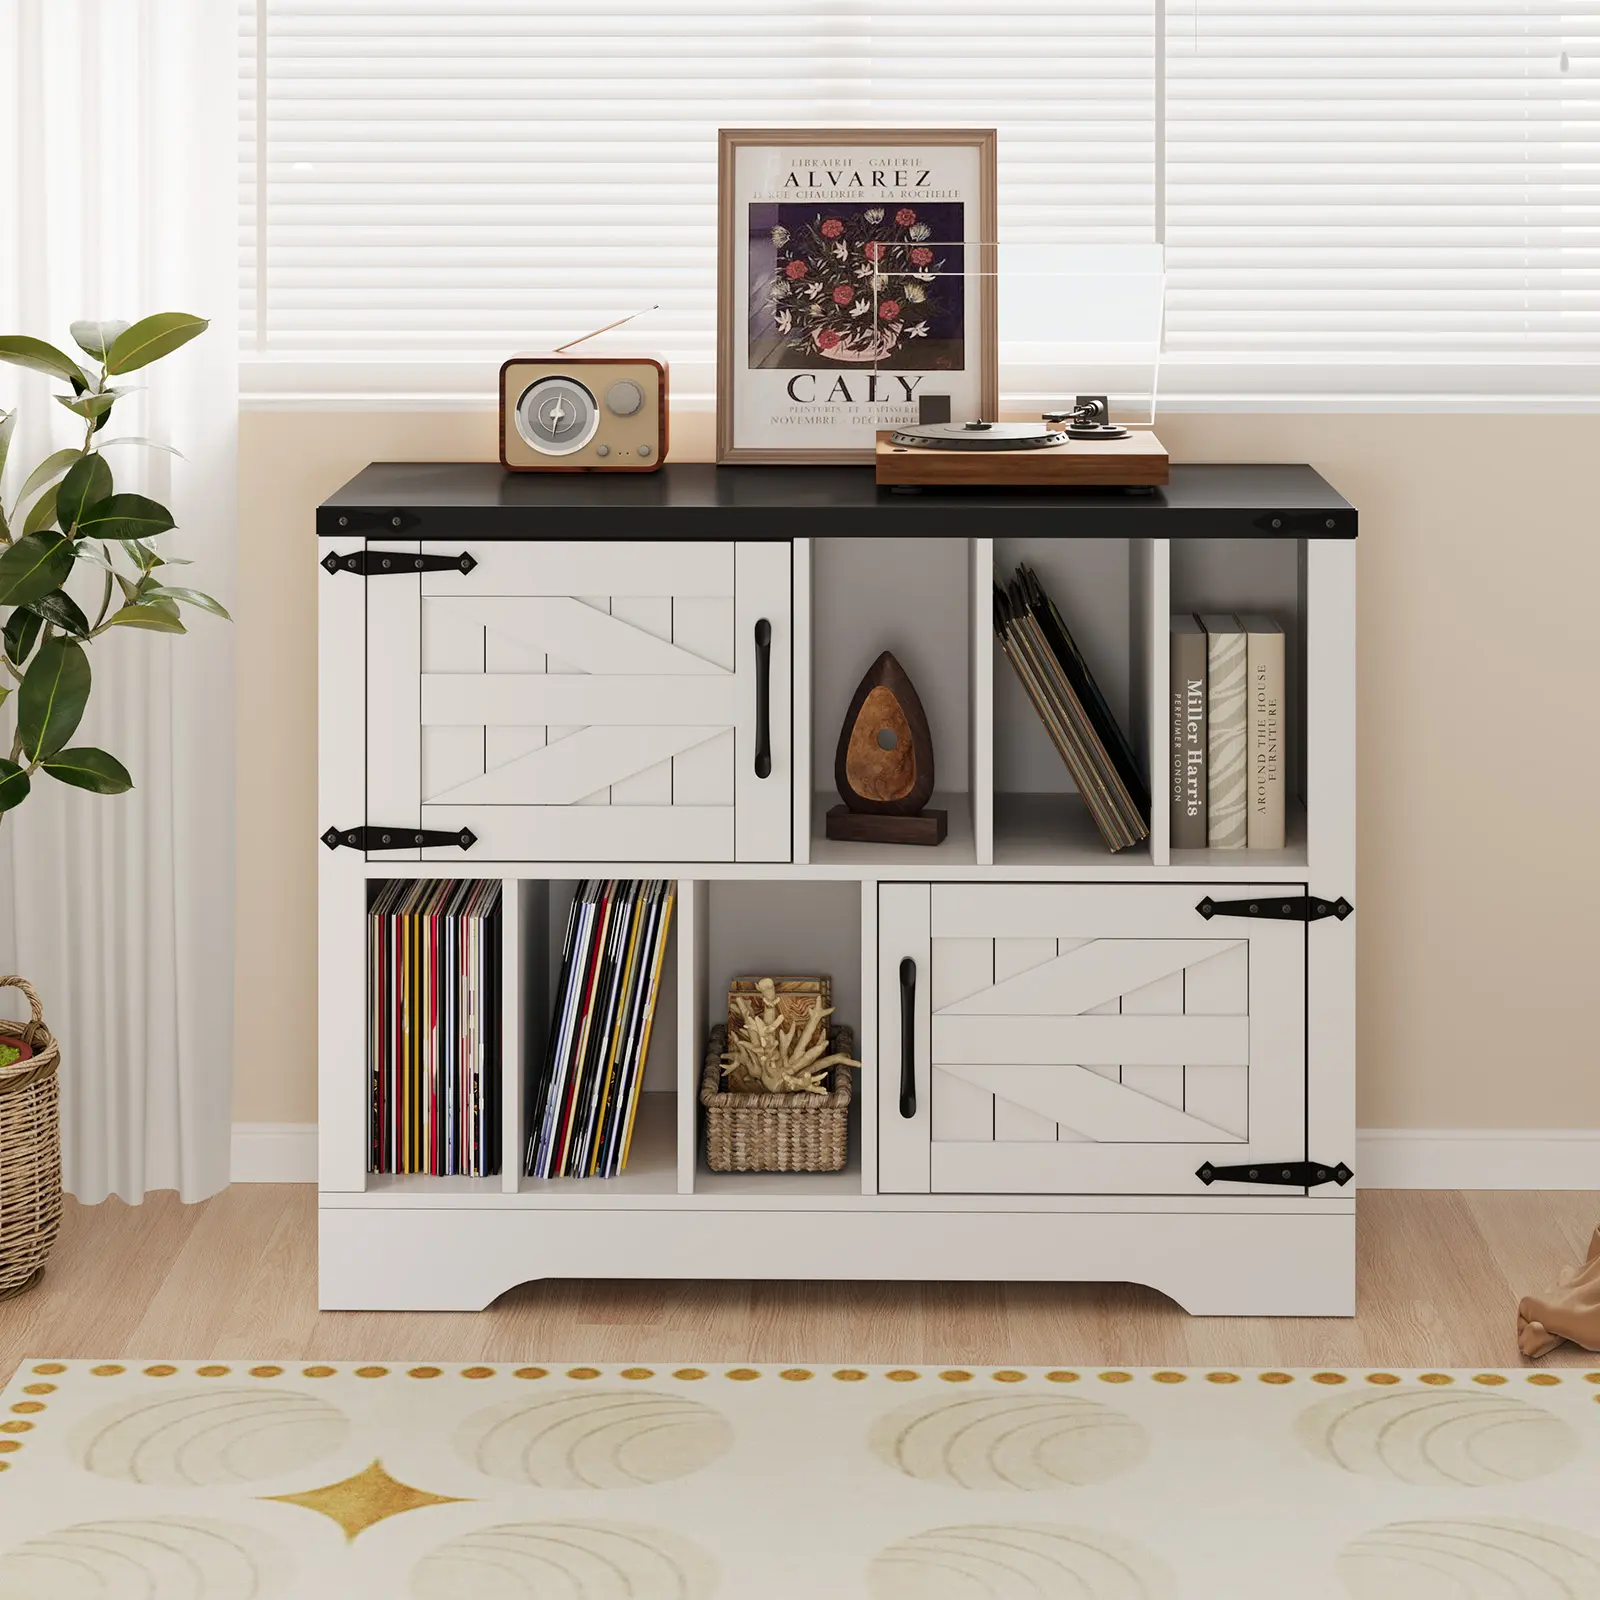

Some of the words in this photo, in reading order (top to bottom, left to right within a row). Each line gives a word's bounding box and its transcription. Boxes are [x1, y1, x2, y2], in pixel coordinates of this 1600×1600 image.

[783, 170, 932, 188] ALVAREZ
[786, 373, 926, 404] CALY
[770, 416, 837, 425] NOVEMBRE
[1187, 679, 1203, 744] Miller
[1257, 664, 1267, 713] HOUSE
[1174, 693, 1182, 749] PERFUMER
[1257, 719, 1267, 748] THE
[1268, 698, 1277, 781] FURNITURE
[1174, 754, 1182, 802] LONDON
[1187, 749, 1203, 817] Harris
[1257, 753, 1267, 815] AROUND
